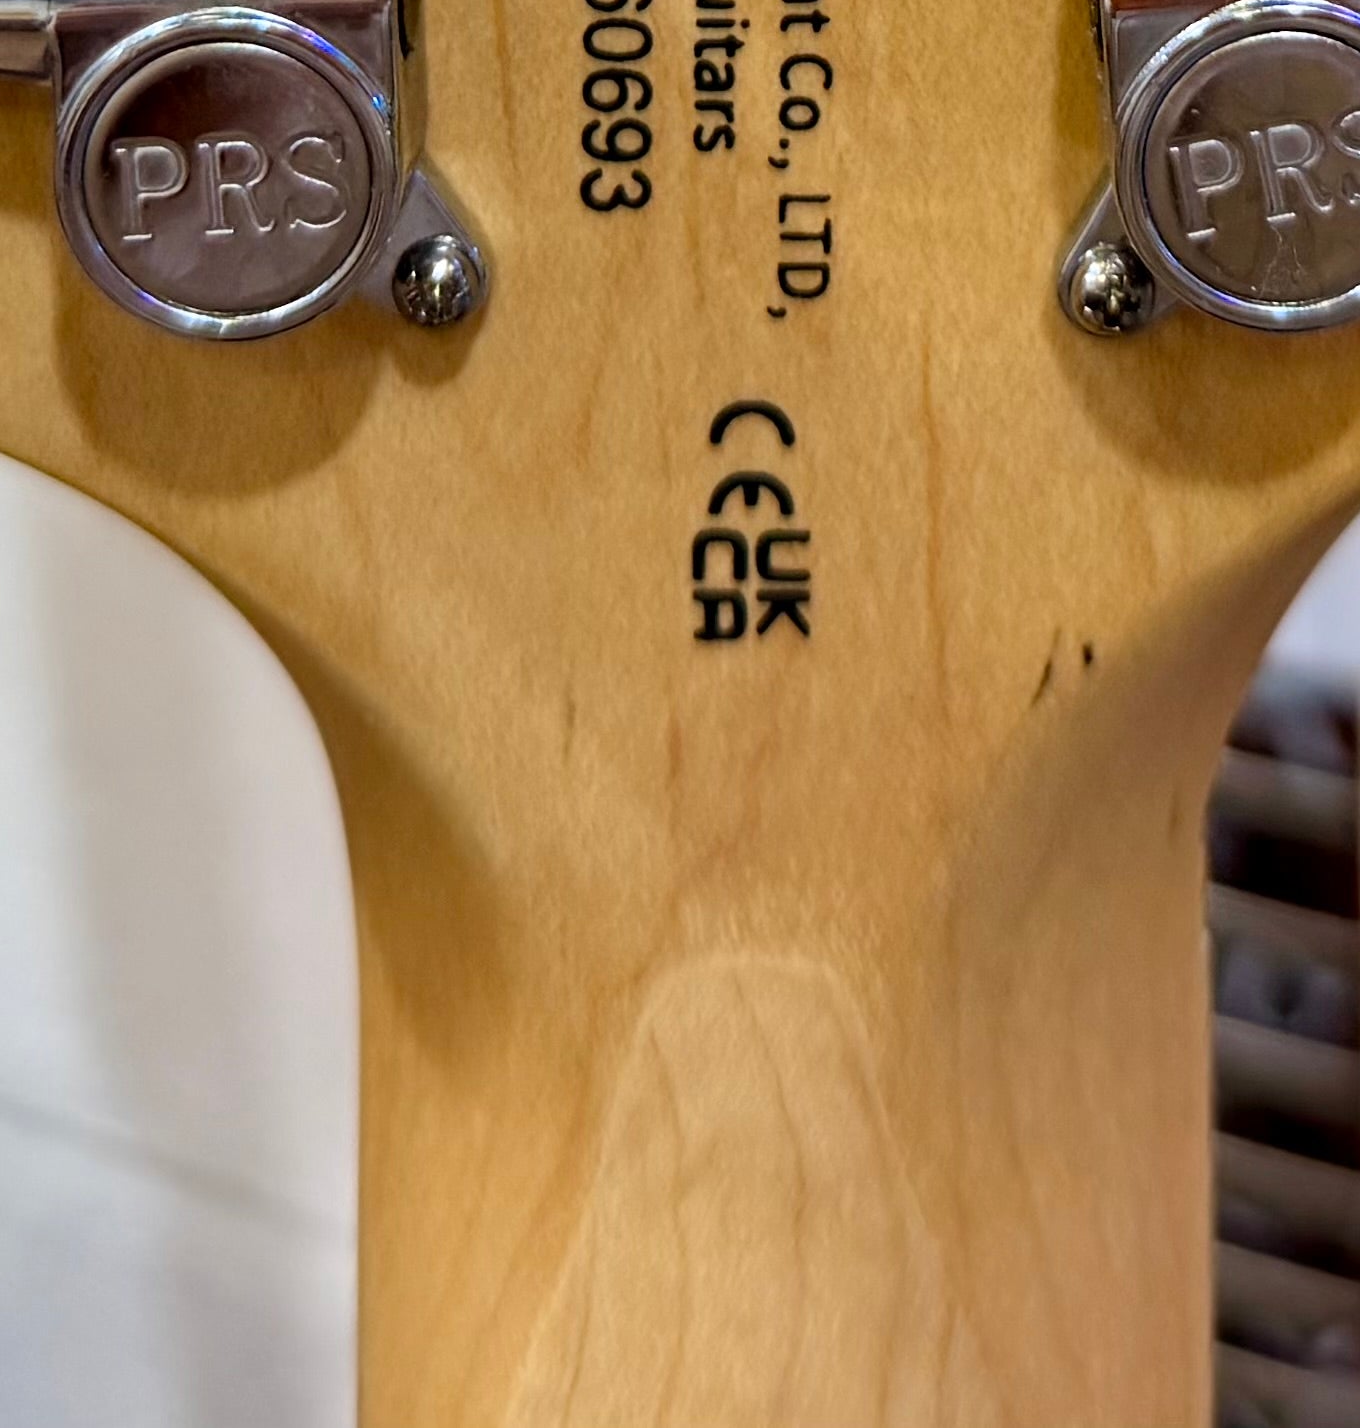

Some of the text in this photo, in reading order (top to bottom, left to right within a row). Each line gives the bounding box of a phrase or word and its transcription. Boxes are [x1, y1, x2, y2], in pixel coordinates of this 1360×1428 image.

[767, 52, 834, 173] Co.,
[112, 135, 348, 241] PRS
[766, 193, 833, 323] LTD,
[690, 526, 750, 647] CA
[752, 527, 812, 641] UK
